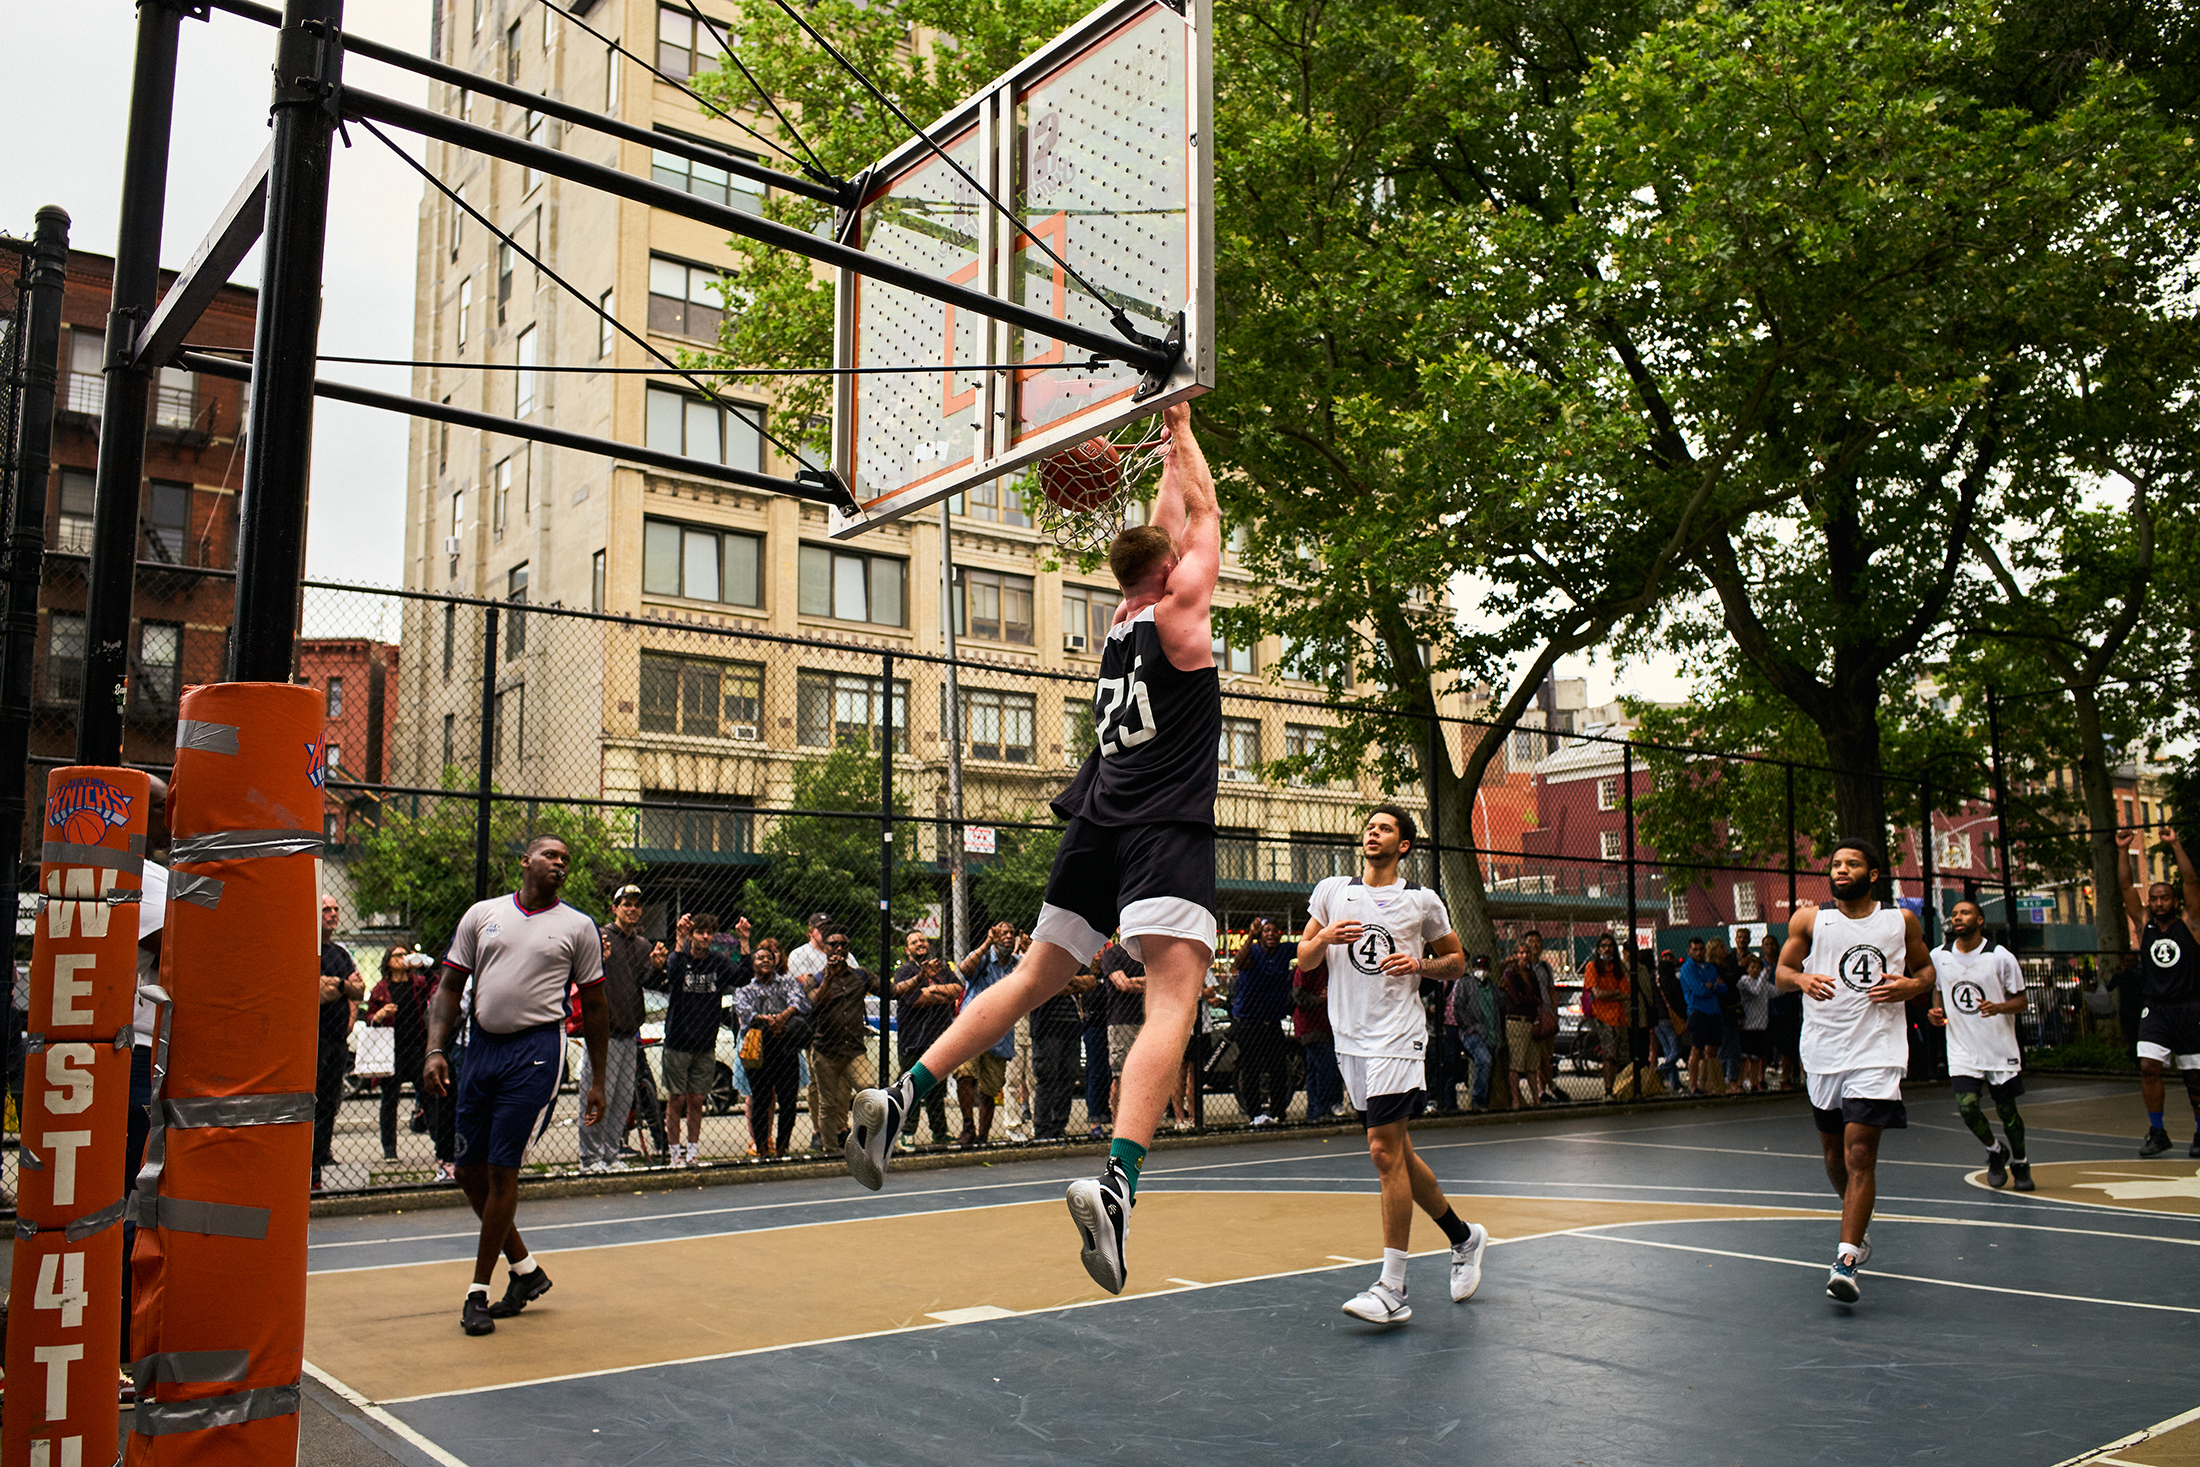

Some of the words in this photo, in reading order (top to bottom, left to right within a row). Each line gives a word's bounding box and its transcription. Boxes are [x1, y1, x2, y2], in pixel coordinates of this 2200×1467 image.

[1095, 654, 1157, 758] 25
[48, 784, 131, 820] KNICKS
[1359, 933, 1377, 965] 4
[2157, 944, 2170, 962] 4
[1852, 954, 1872, 983] 4
[1960, 987, 1974, 1008] 4
[42, 868, 118, 1206] WEST
